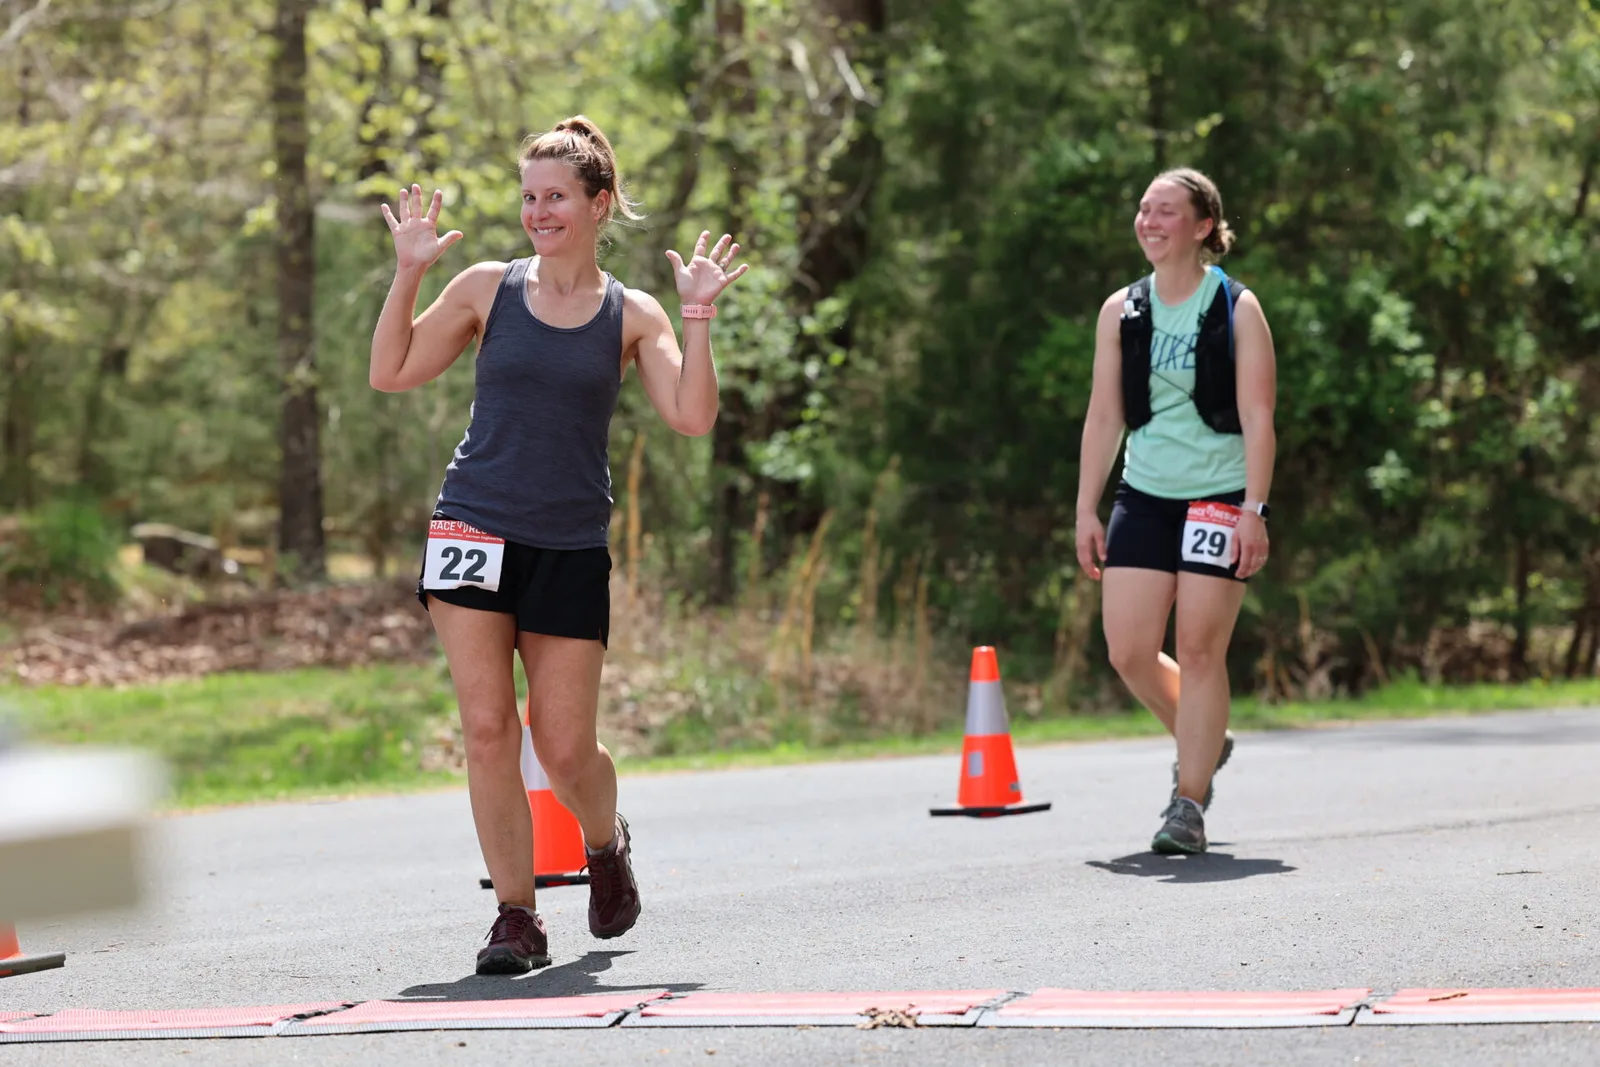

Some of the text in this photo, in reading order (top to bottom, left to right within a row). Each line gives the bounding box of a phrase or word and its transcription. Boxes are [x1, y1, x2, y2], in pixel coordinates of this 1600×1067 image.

[430, 520, 456, 531] RACE
[1191, 528, 1227, 557] 29
[439, 546, 488, 583] 22
